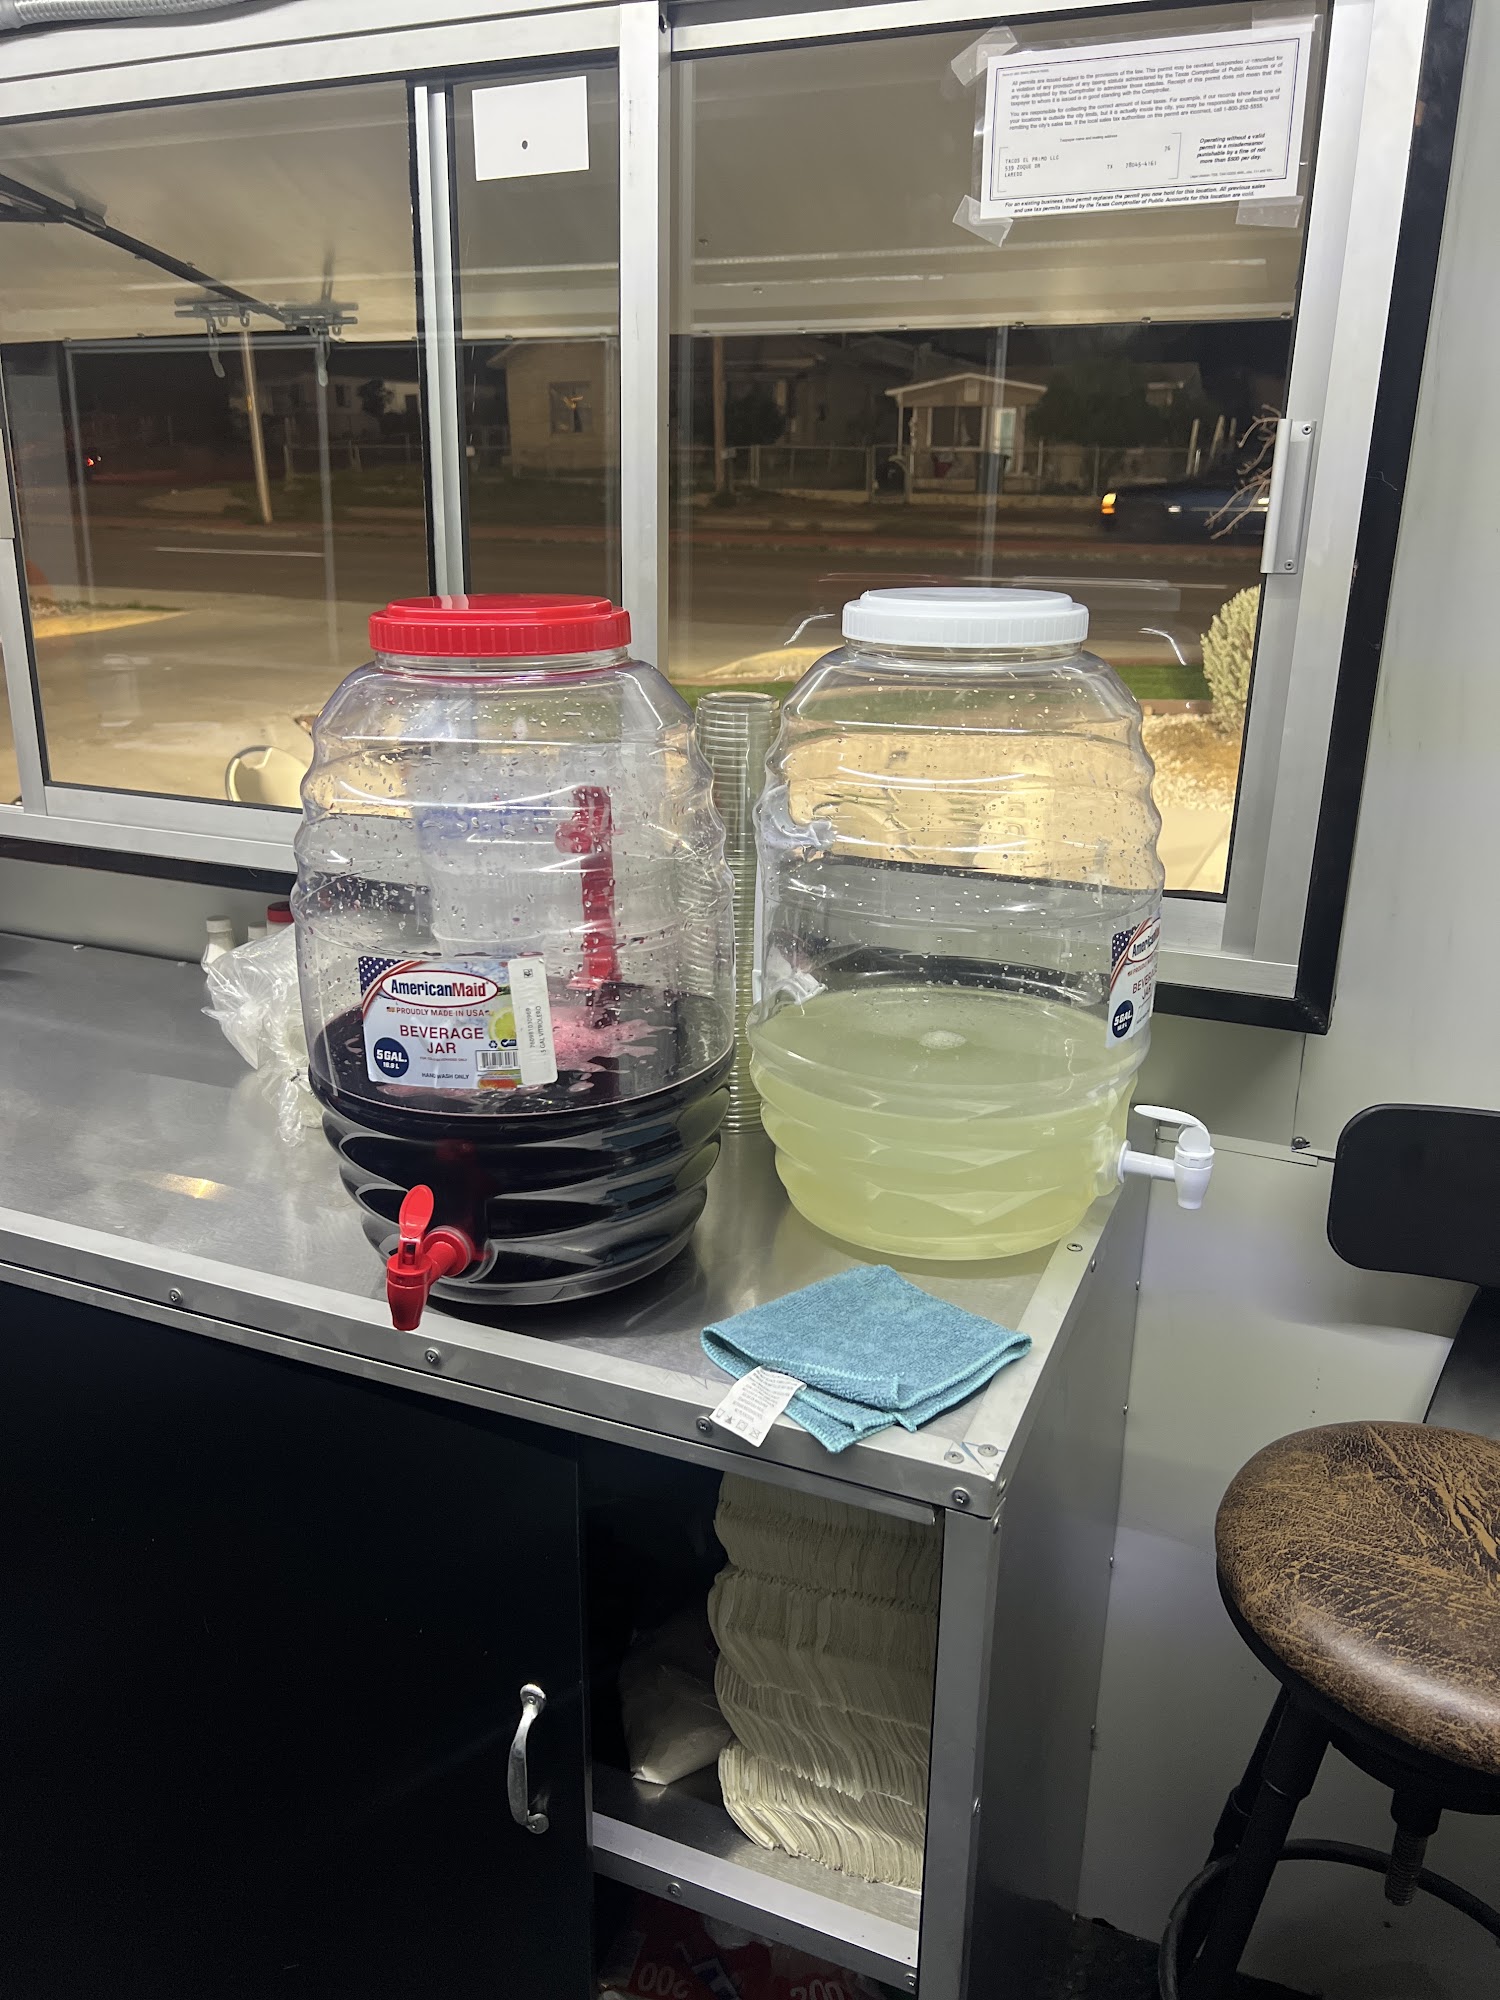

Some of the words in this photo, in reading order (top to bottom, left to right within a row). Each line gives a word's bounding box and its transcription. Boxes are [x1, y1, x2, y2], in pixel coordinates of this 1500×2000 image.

[391, 979, 486, 997] AmericanMaid
[396, 1007, 428, 1015] PROUDLY
[466, 1009, 485, 1017] USA
[400, 1025, 484, 1040] BEVERAGE
[427, 1042, 457, 1054] JAR
